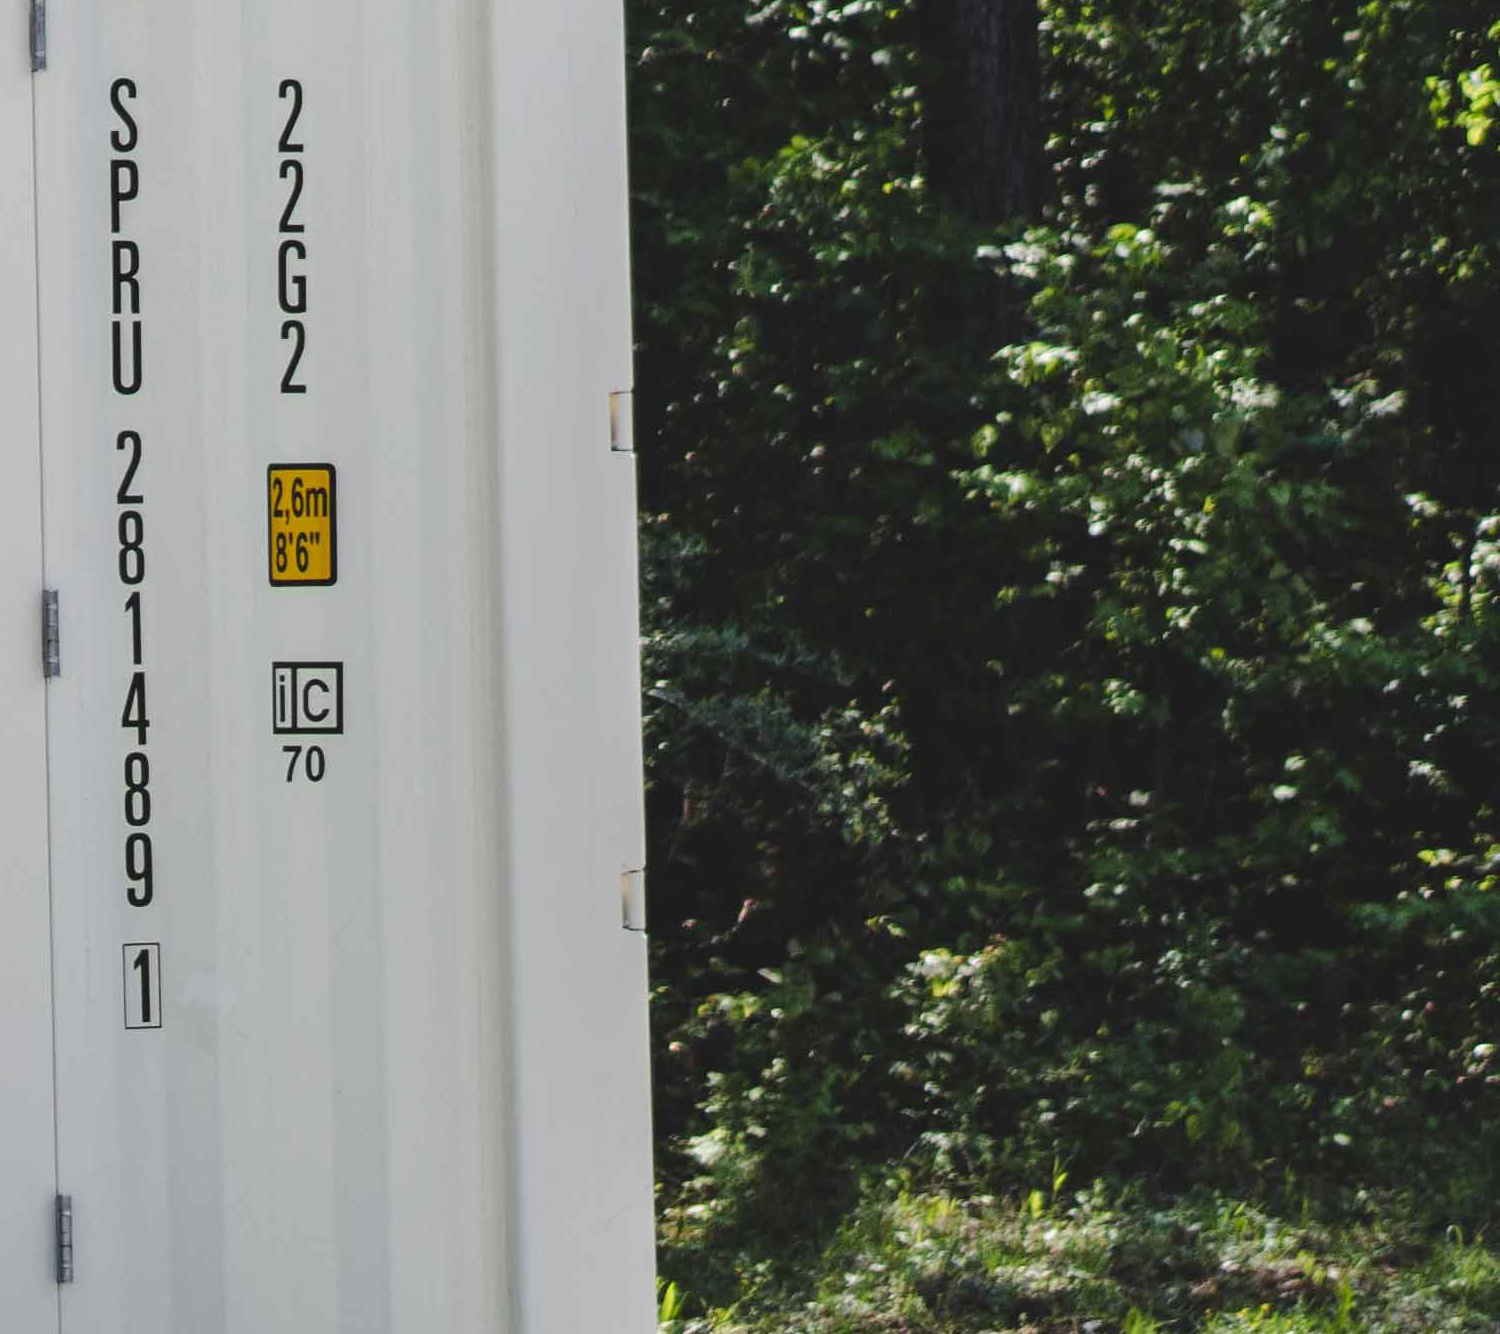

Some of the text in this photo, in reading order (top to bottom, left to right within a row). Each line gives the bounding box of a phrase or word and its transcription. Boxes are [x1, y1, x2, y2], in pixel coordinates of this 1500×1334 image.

[278, 78, 307, 394] 22G2
[272, 476, 329, 525] 2,6m
[110, 77, 154, 1023] SPRU 281489 1
[275, 531, 321, 573] 8'6"
[282, 745, 326, 783] 70
